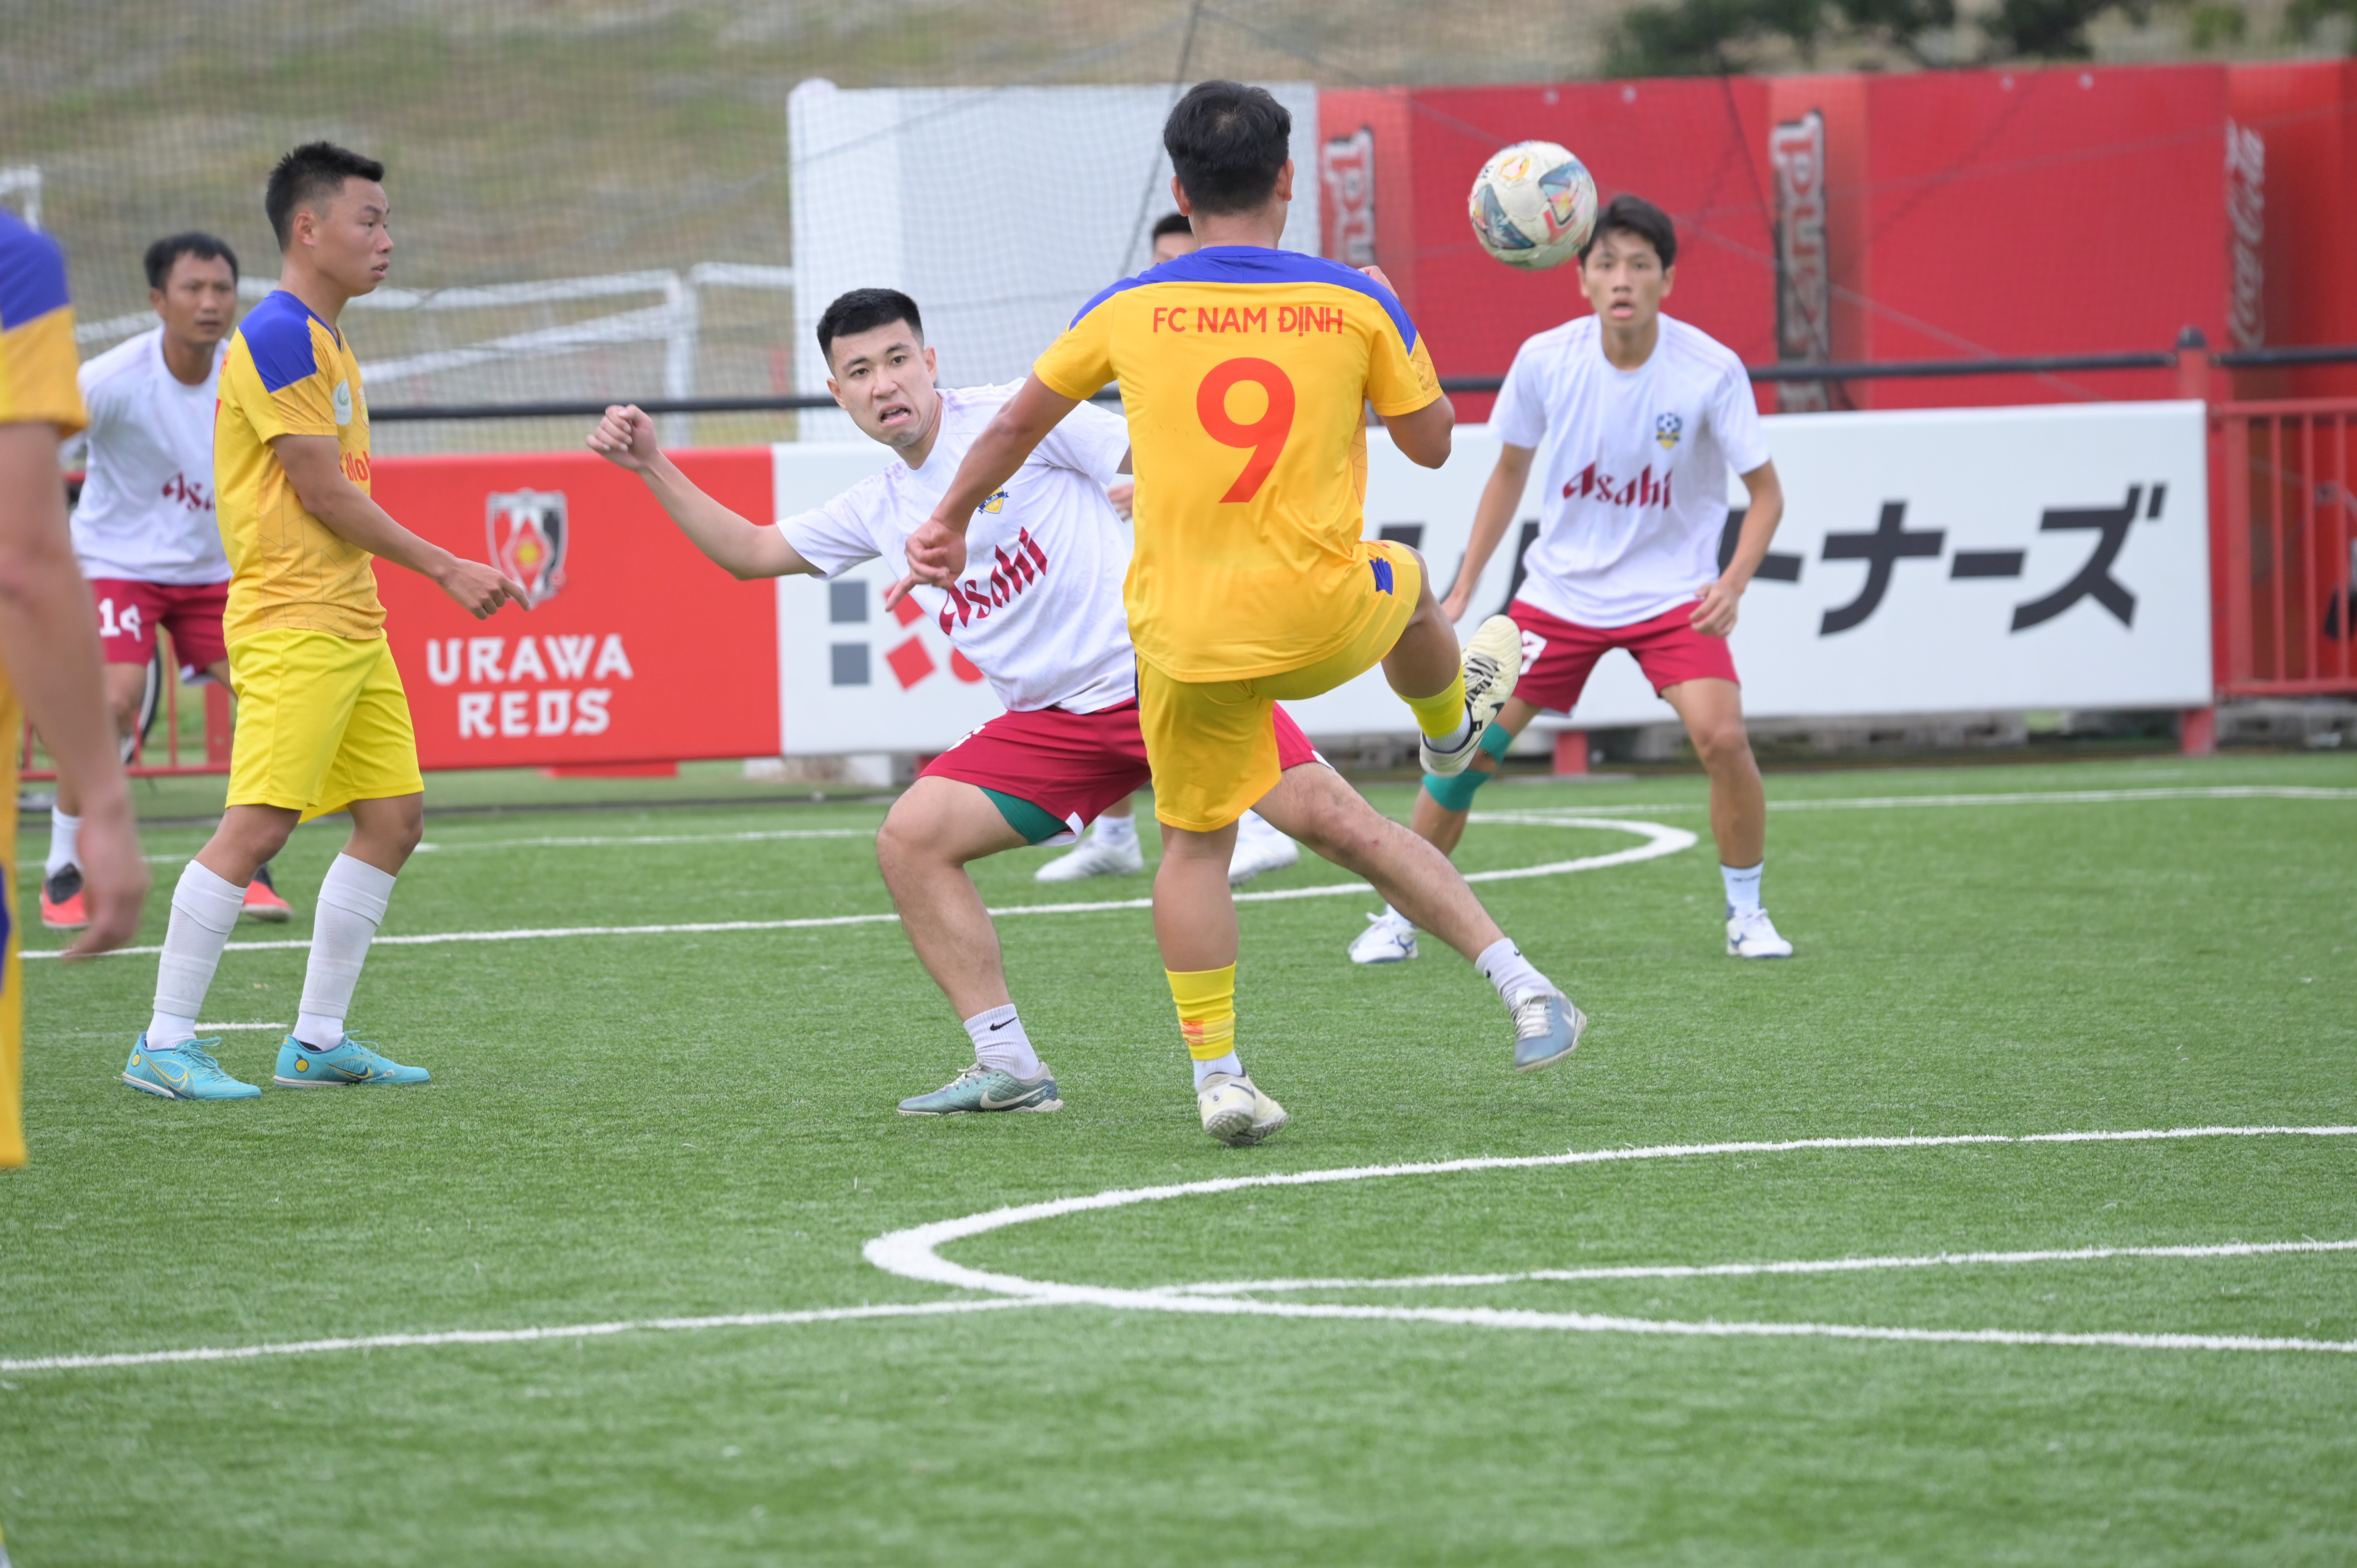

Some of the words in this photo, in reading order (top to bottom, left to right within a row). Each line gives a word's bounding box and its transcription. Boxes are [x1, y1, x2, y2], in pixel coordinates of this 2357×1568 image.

[1153, 307, 1187, 332] FC
[1197, 307, 1267, 333] NAM
[1277, 306, 1343, 337] ĐỊNH
[1196, 357, 1295, 503] 9
[1563, 463, 1673, 509] Asahi
[940, 526, 1048, 636] Asahi
[98, 597, 142, 642] 14
[427, 634, 633, 685] URAWA
[458, 688, 611, 737] REDS
